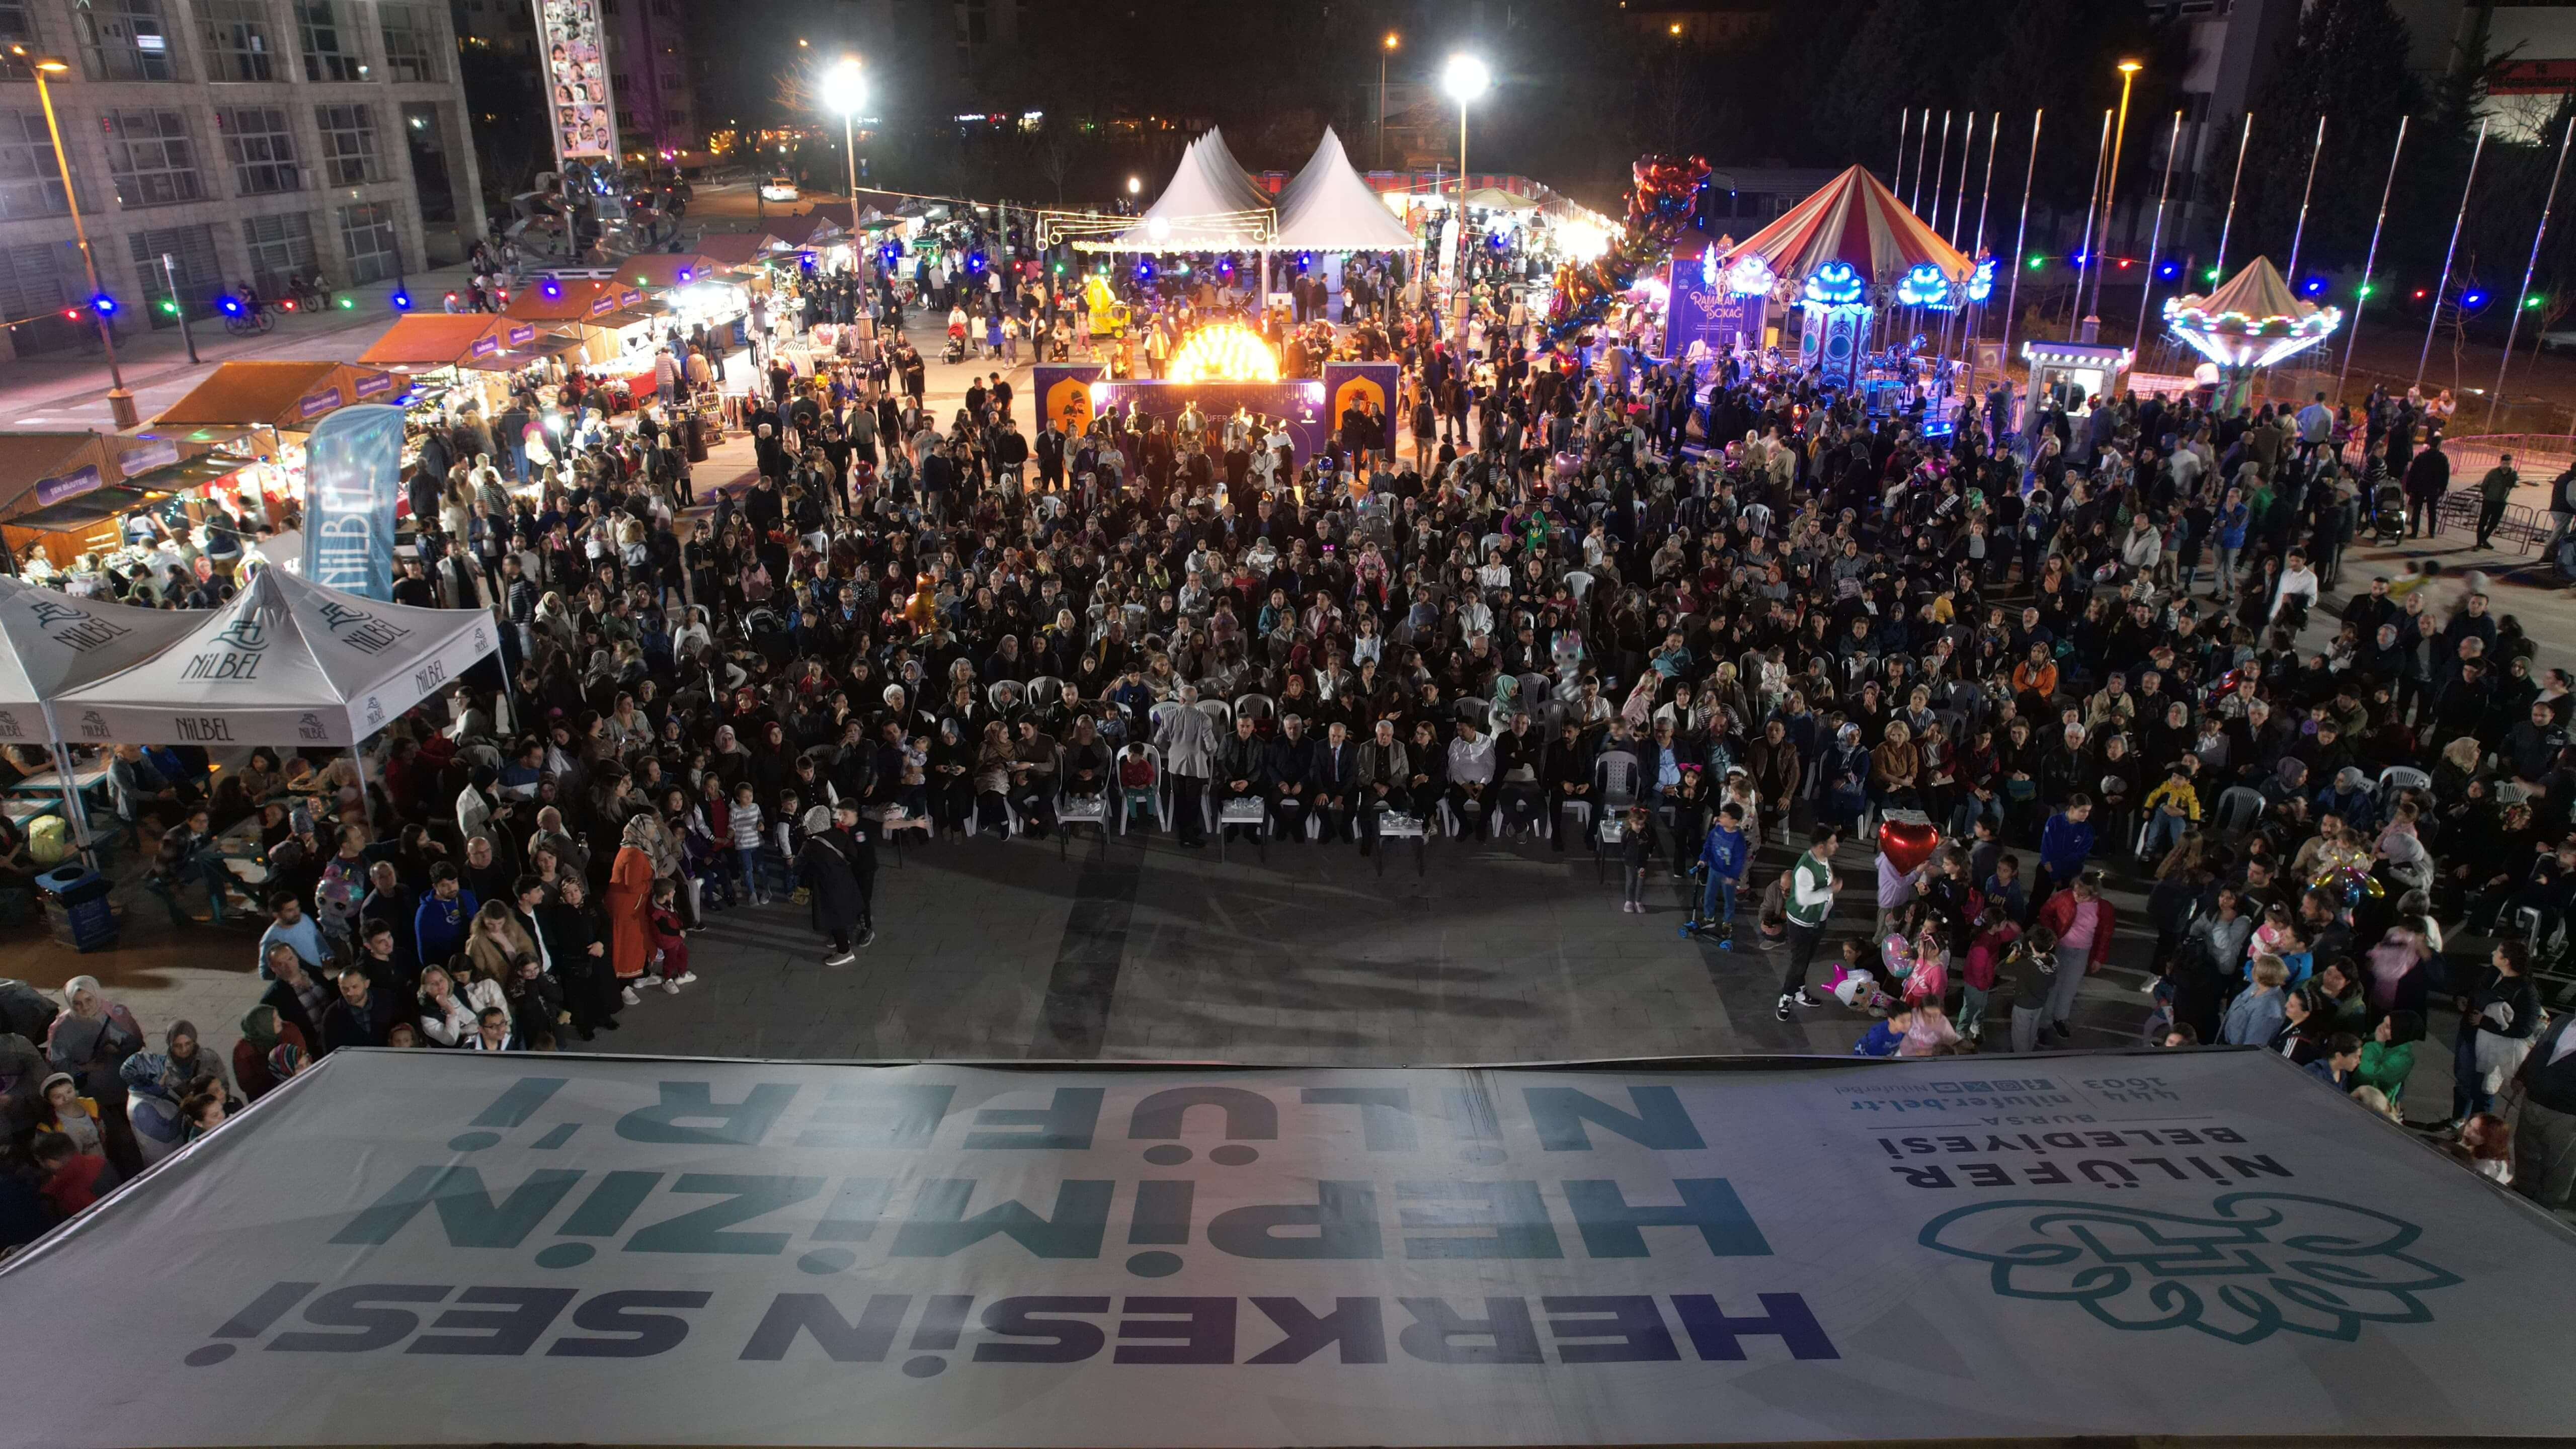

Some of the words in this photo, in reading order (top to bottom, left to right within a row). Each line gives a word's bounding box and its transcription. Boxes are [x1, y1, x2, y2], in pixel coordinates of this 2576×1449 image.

[0, 725, 25, 737] İLBEL
[2082, 1076, 2167, 1090] 1603
[2102, 1087, 2181, 1102] 444
[1850, 1094, 2073, 1112] nilufer.bel.tr
[1980, 1114, 2098, 1125] BURSA
[1877, 1127, 2248, 1159] BELEDİYESİ
[1889, 1154, 2294, 1189] NİLÜFER
[328, 1169, 1774, 1278] HEPİMİZİN
[185, 1280, 715, 1367] SESİ
[741, 1291, 1841, 1379] HERKESİN
